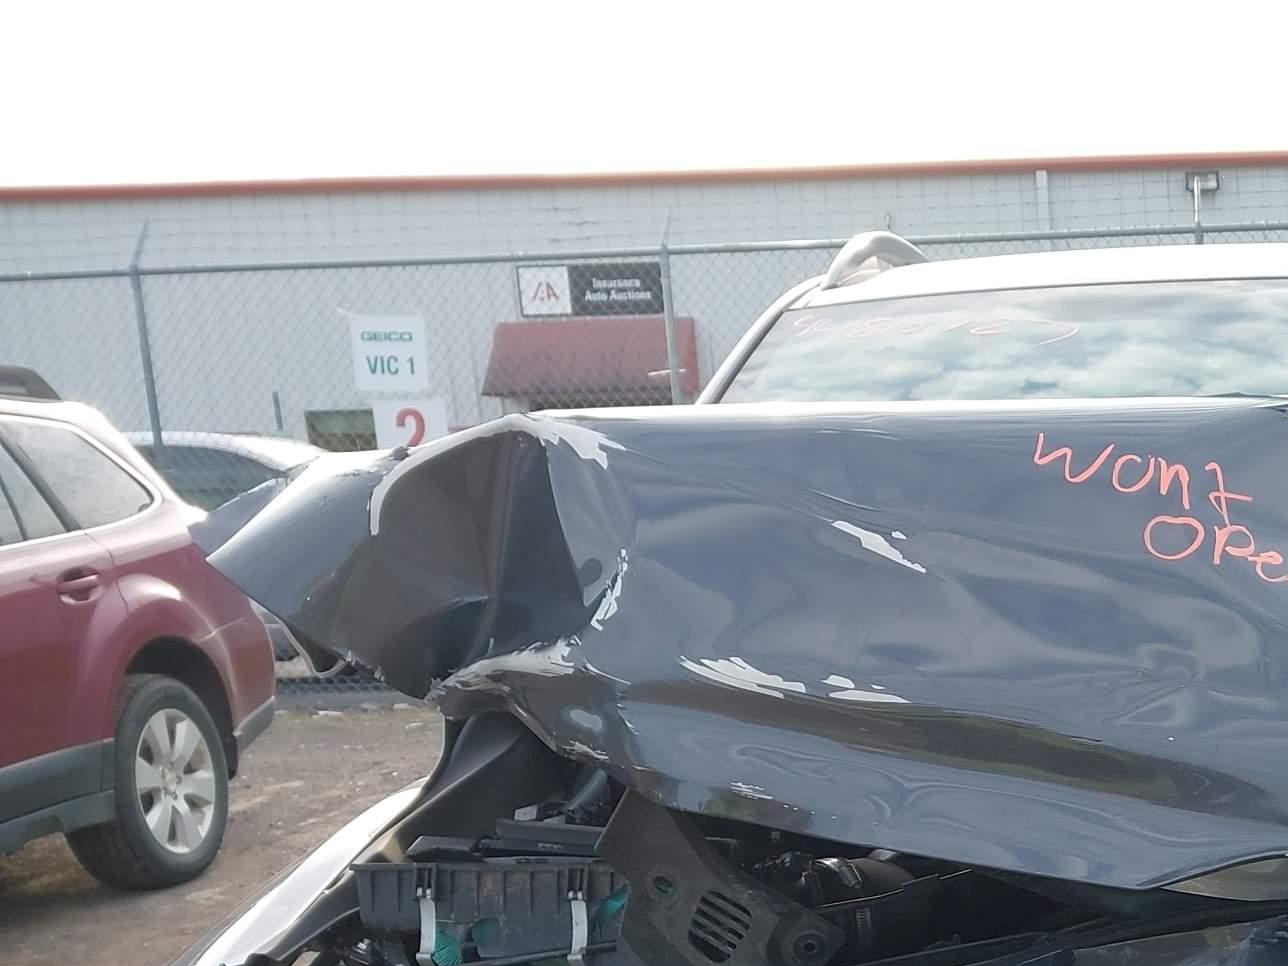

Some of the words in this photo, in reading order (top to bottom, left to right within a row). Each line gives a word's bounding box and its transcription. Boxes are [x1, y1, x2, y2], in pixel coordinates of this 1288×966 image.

[584, 290, 608, 301] Auto
[609, 289, 652, 301] Auctions
[360, 330, 413, 342] GEICO
[366, 355, 400, 376] VIC
[406, 356, 415, 376] 1
[395, 407, 426, 448] 2
